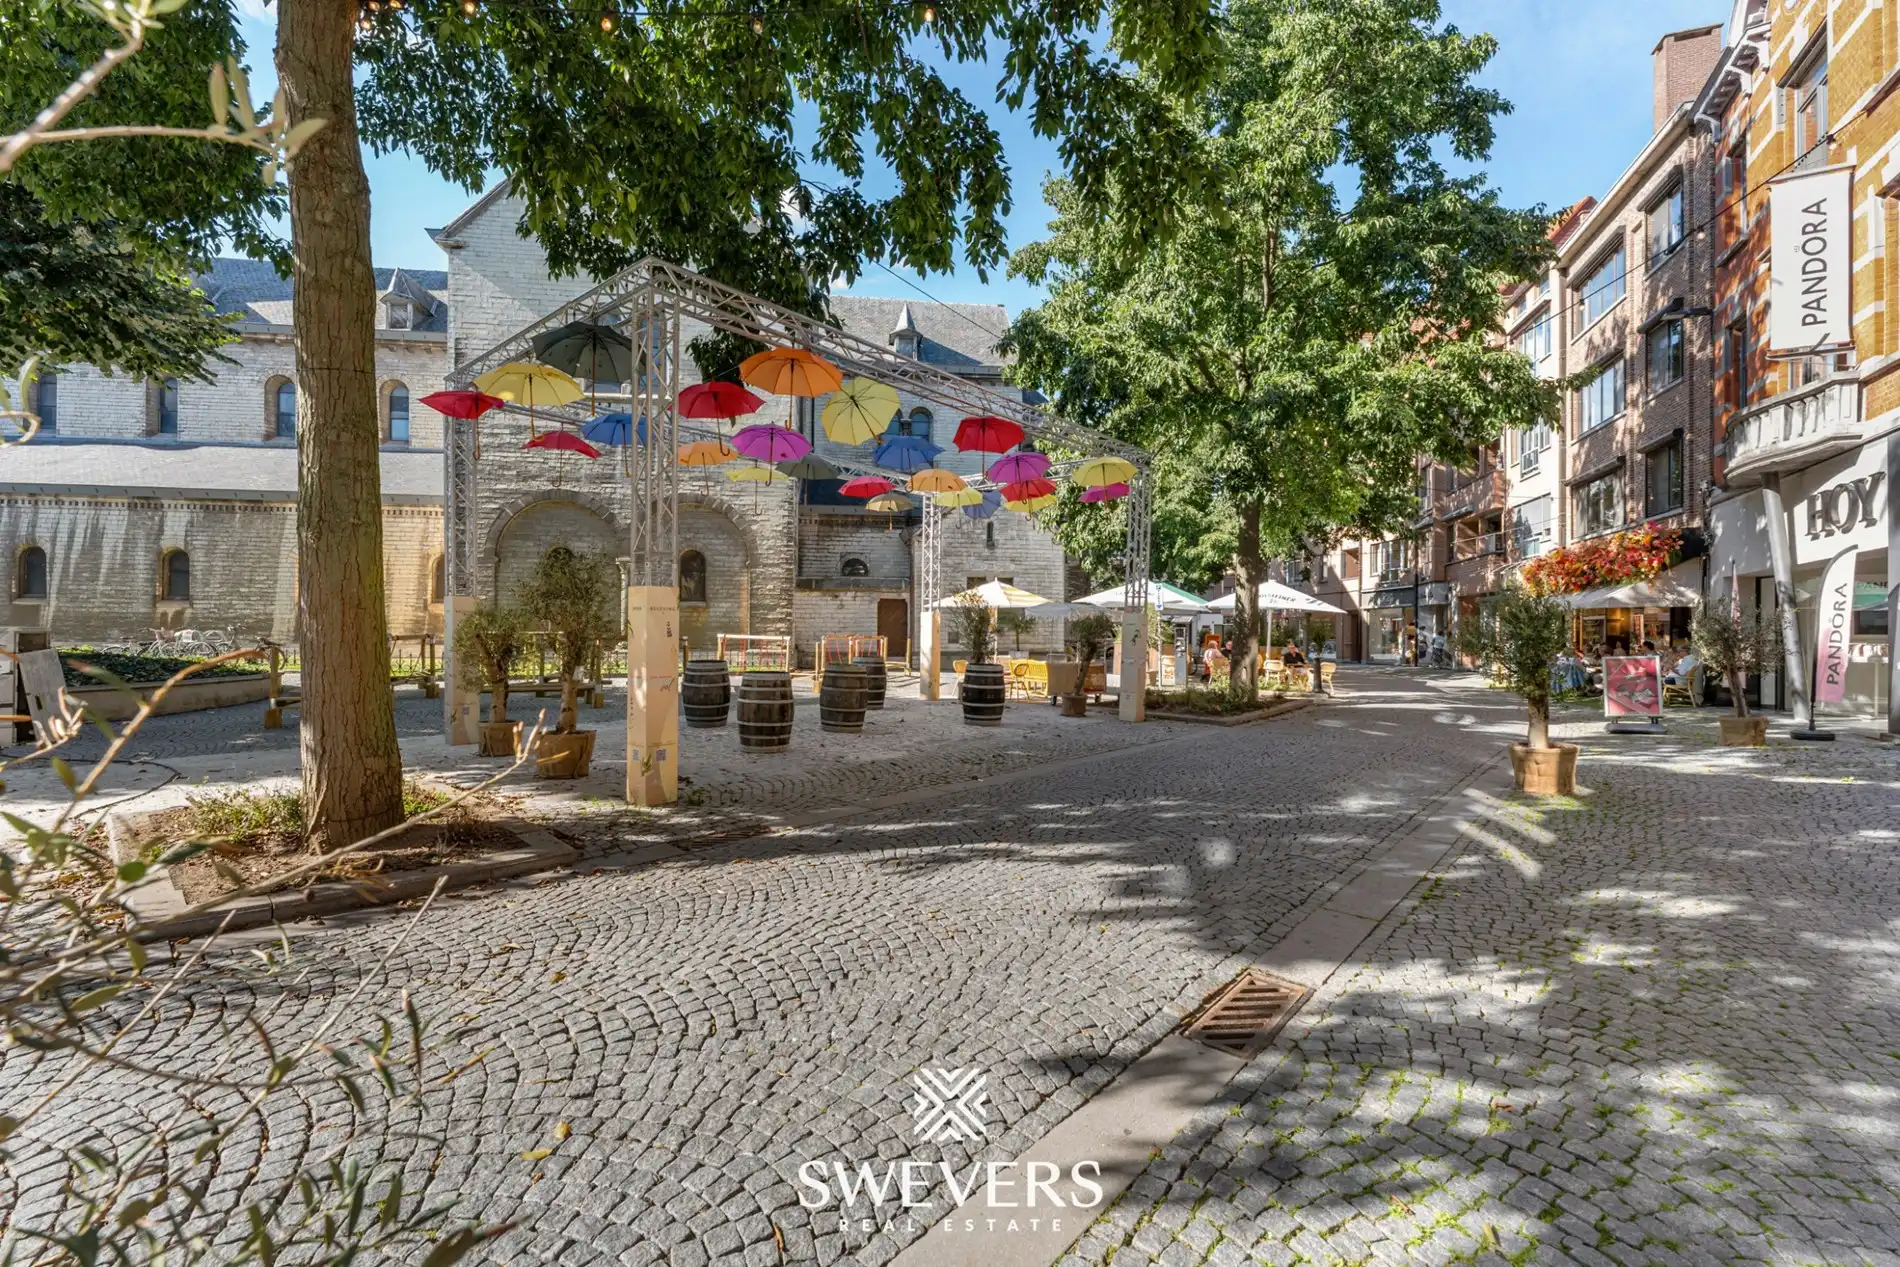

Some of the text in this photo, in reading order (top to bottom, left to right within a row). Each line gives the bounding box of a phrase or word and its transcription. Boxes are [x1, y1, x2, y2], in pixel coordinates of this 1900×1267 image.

[1801, 197, 1828, 327] PANDORA
[1804, 471, 1887, 542] HOY
[1826, 582, 1848, 685] PANDORA
